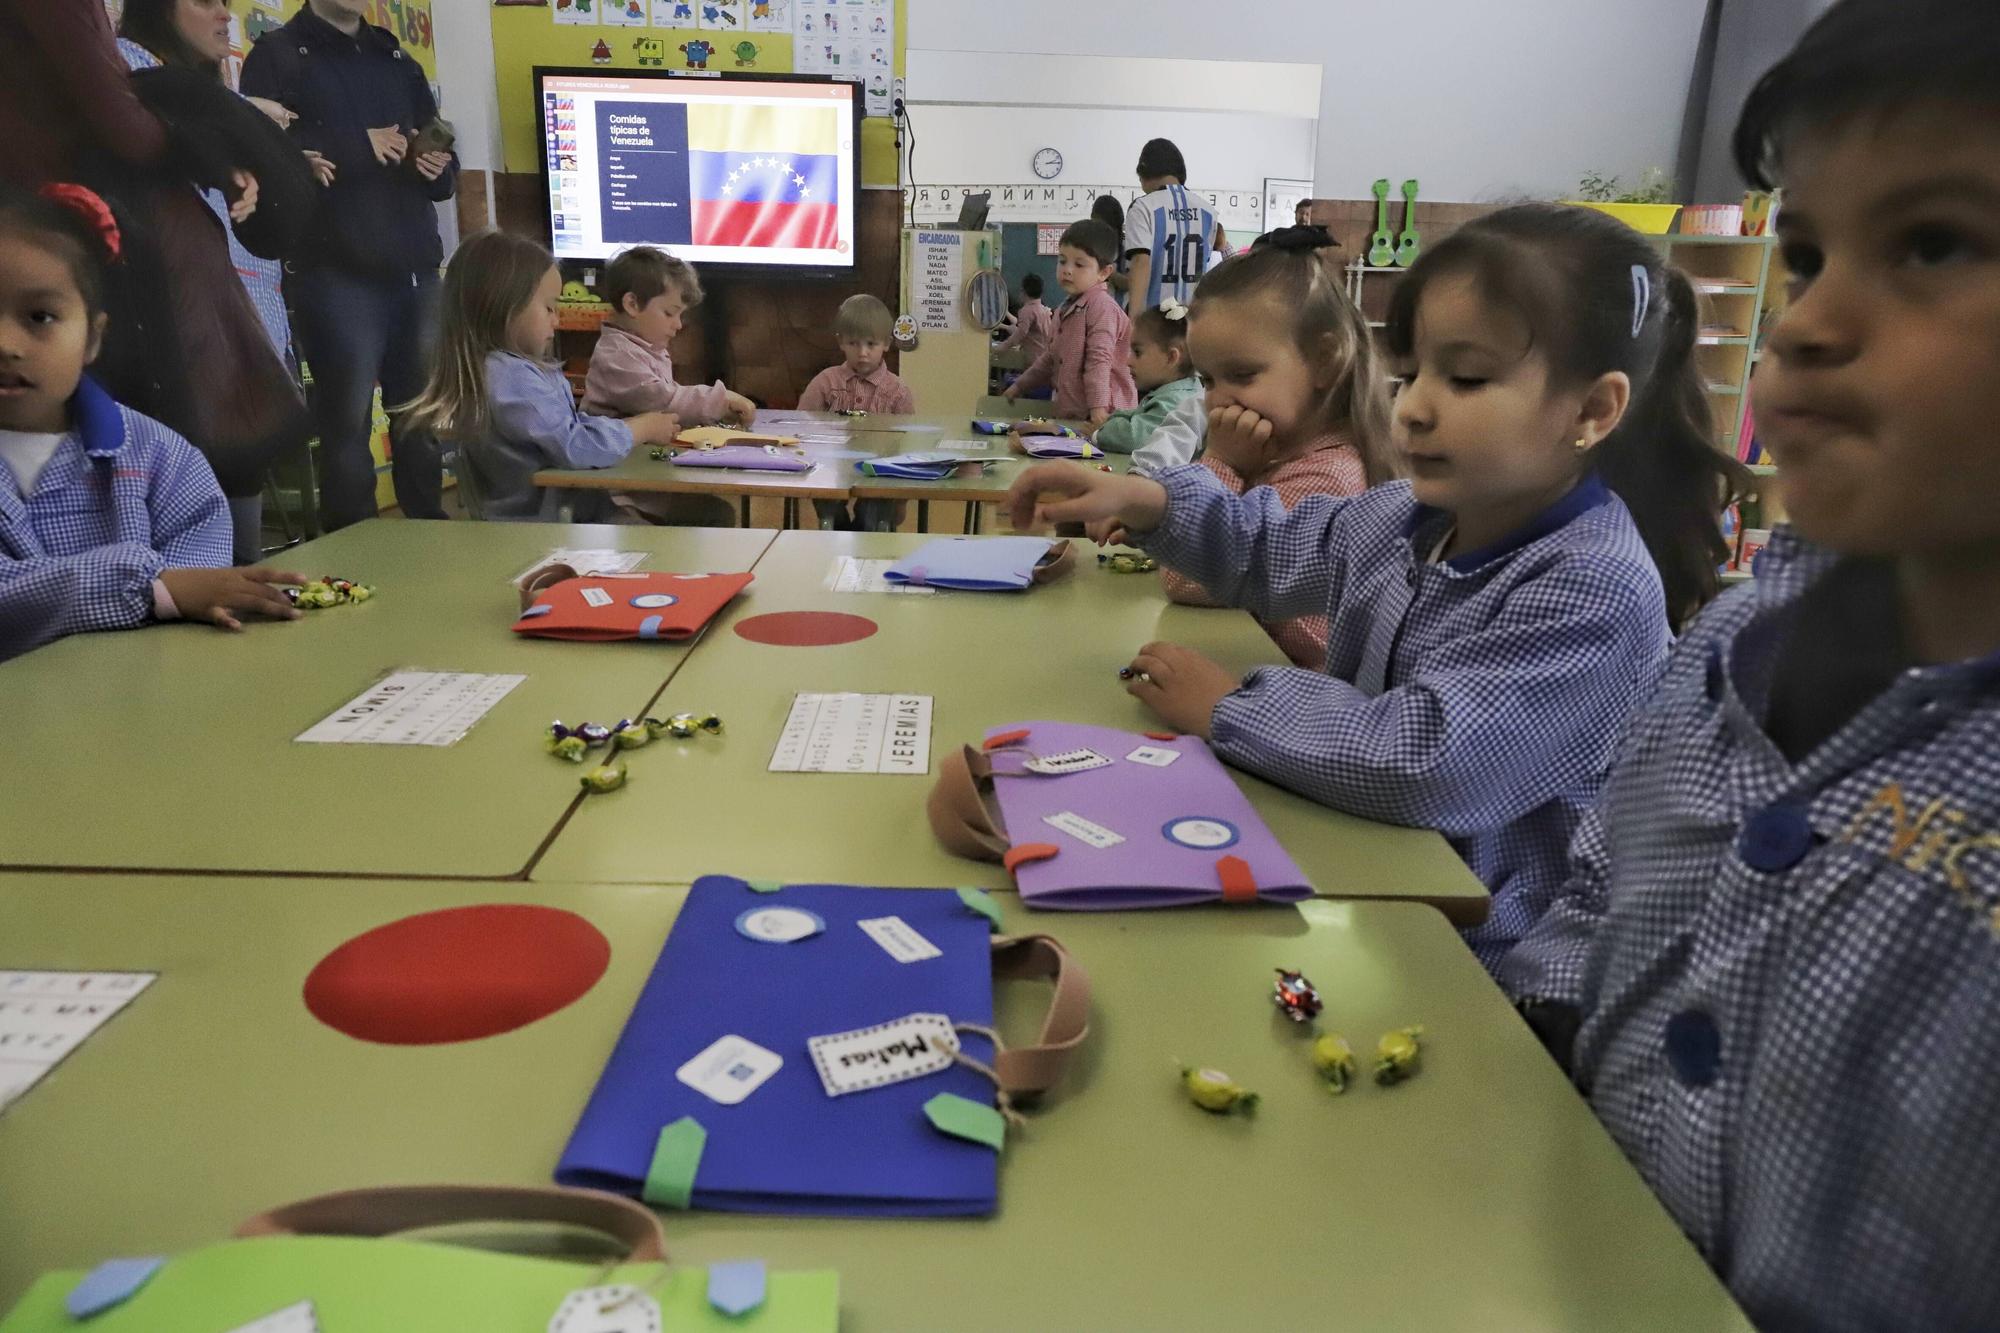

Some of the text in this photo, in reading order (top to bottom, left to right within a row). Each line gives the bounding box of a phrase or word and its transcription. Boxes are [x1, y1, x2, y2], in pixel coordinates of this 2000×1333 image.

[609, 114, 647, 124] Comidas
[639, 125, 650, 135] de
[610, 135, 654, 146] Venezuela
[1168, 208, 1199, 221] MESSI
[1162, 233, 1204, 284] 10
